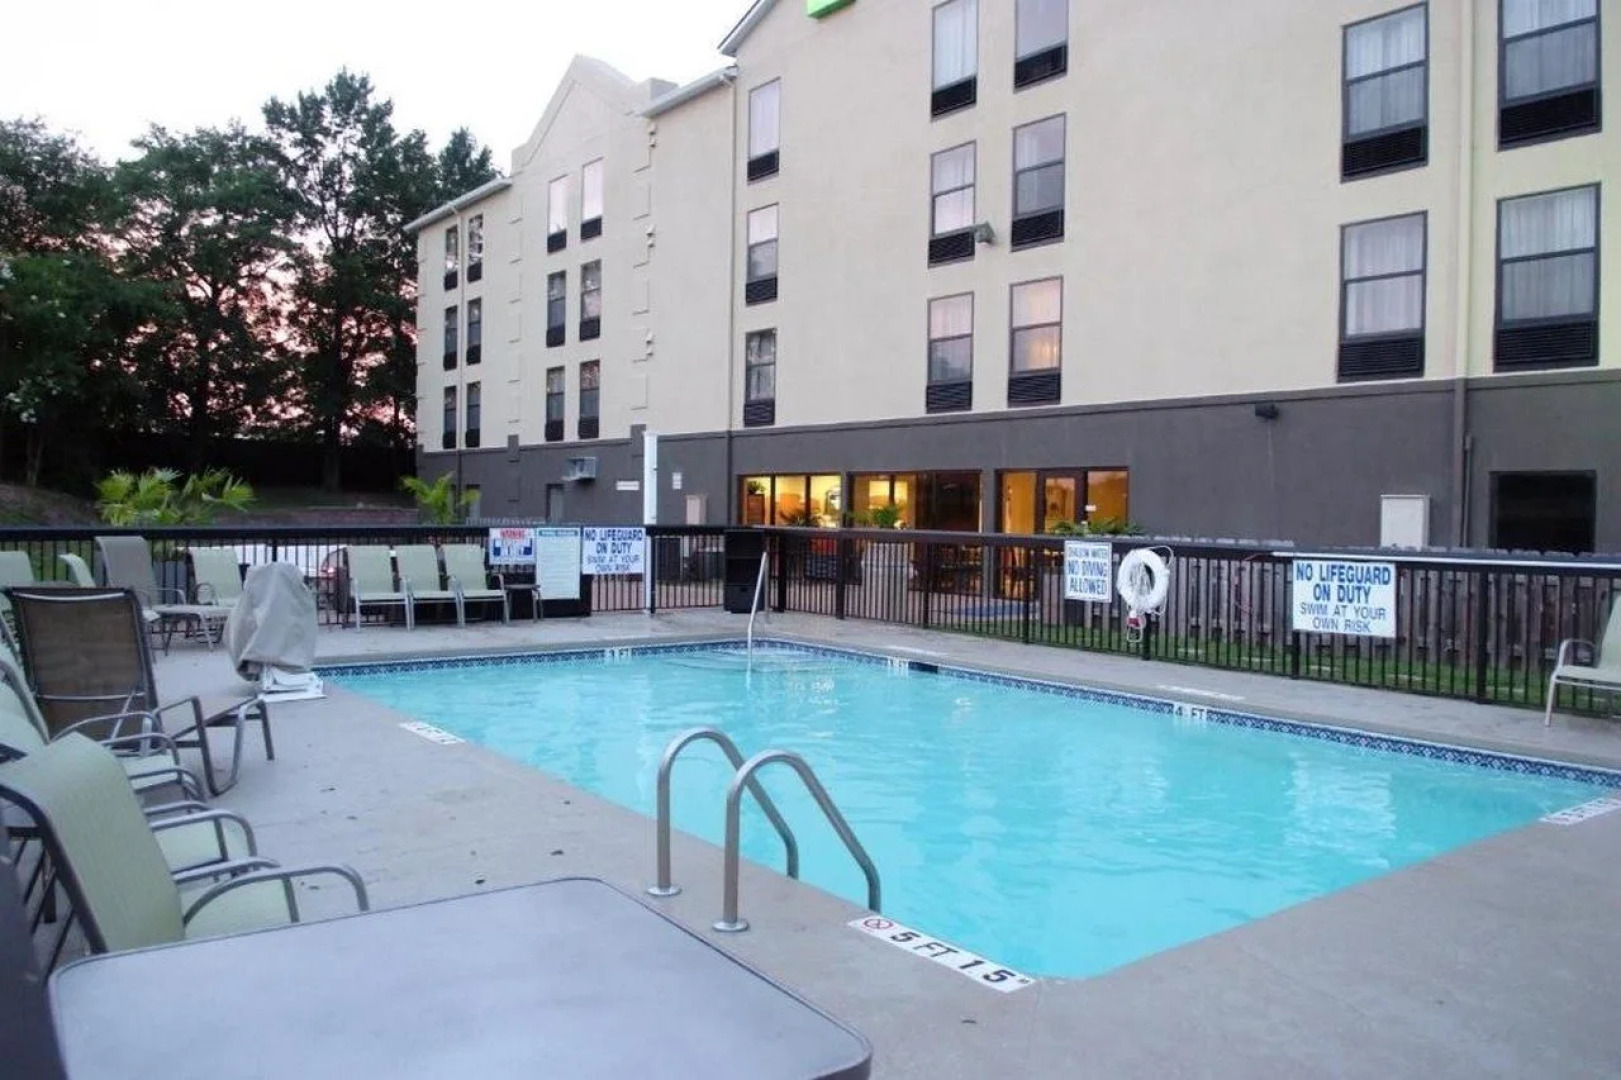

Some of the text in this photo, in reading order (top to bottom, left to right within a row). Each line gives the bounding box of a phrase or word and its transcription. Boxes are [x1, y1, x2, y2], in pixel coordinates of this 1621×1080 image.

[584, 530, 596, 541] NO
[600, 530, 643, 541] LIFEGUARD
[596, 542, 633, 554] ON DUTY
[1068, 560, 1108, 577] NO DIVING
[1296, 562, 1391, 585] NO LIFEGUARD
[1069, 577, 1107, 595] ALLOWED
[1313, 583, 1371, 604] ON DUTY
[1300, 601, 1387, 620] SWIM AT YOUR
[1312, 617, 1372, 633] OWN RISK
[890, 931, 920, 943] 5
[913, 941, 958, 958] FT
